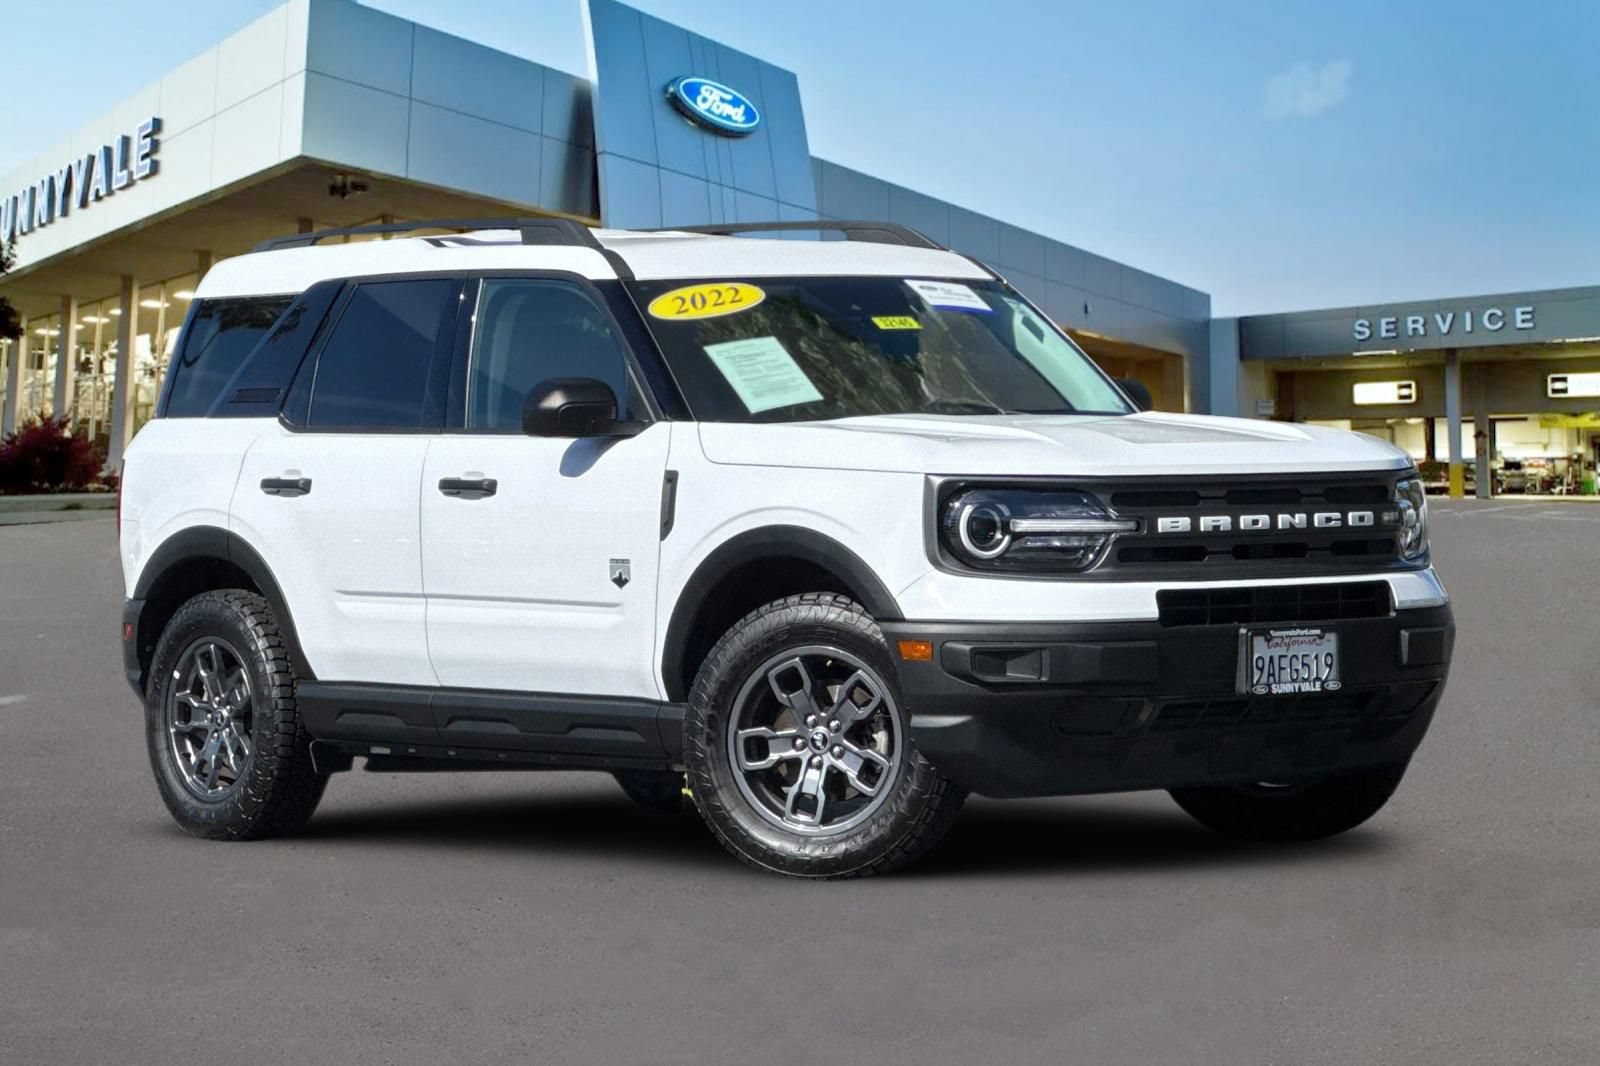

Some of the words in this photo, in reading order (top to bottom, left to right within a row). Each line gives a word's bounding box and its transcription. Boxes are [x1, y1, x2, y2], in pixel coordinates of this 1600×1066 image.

[696, 85, 746, 123] Ford
[0, 117, 163, 243] UNNYVALE
[672, 287, 743, 315] 2022
[1353, 306, 1536, 340] SERVICE
[1157, 511, 1375, 533] BRONCO
[1266, 638, 1323, 652] California
[1254, 652, 1334, 684] 9AFG519
